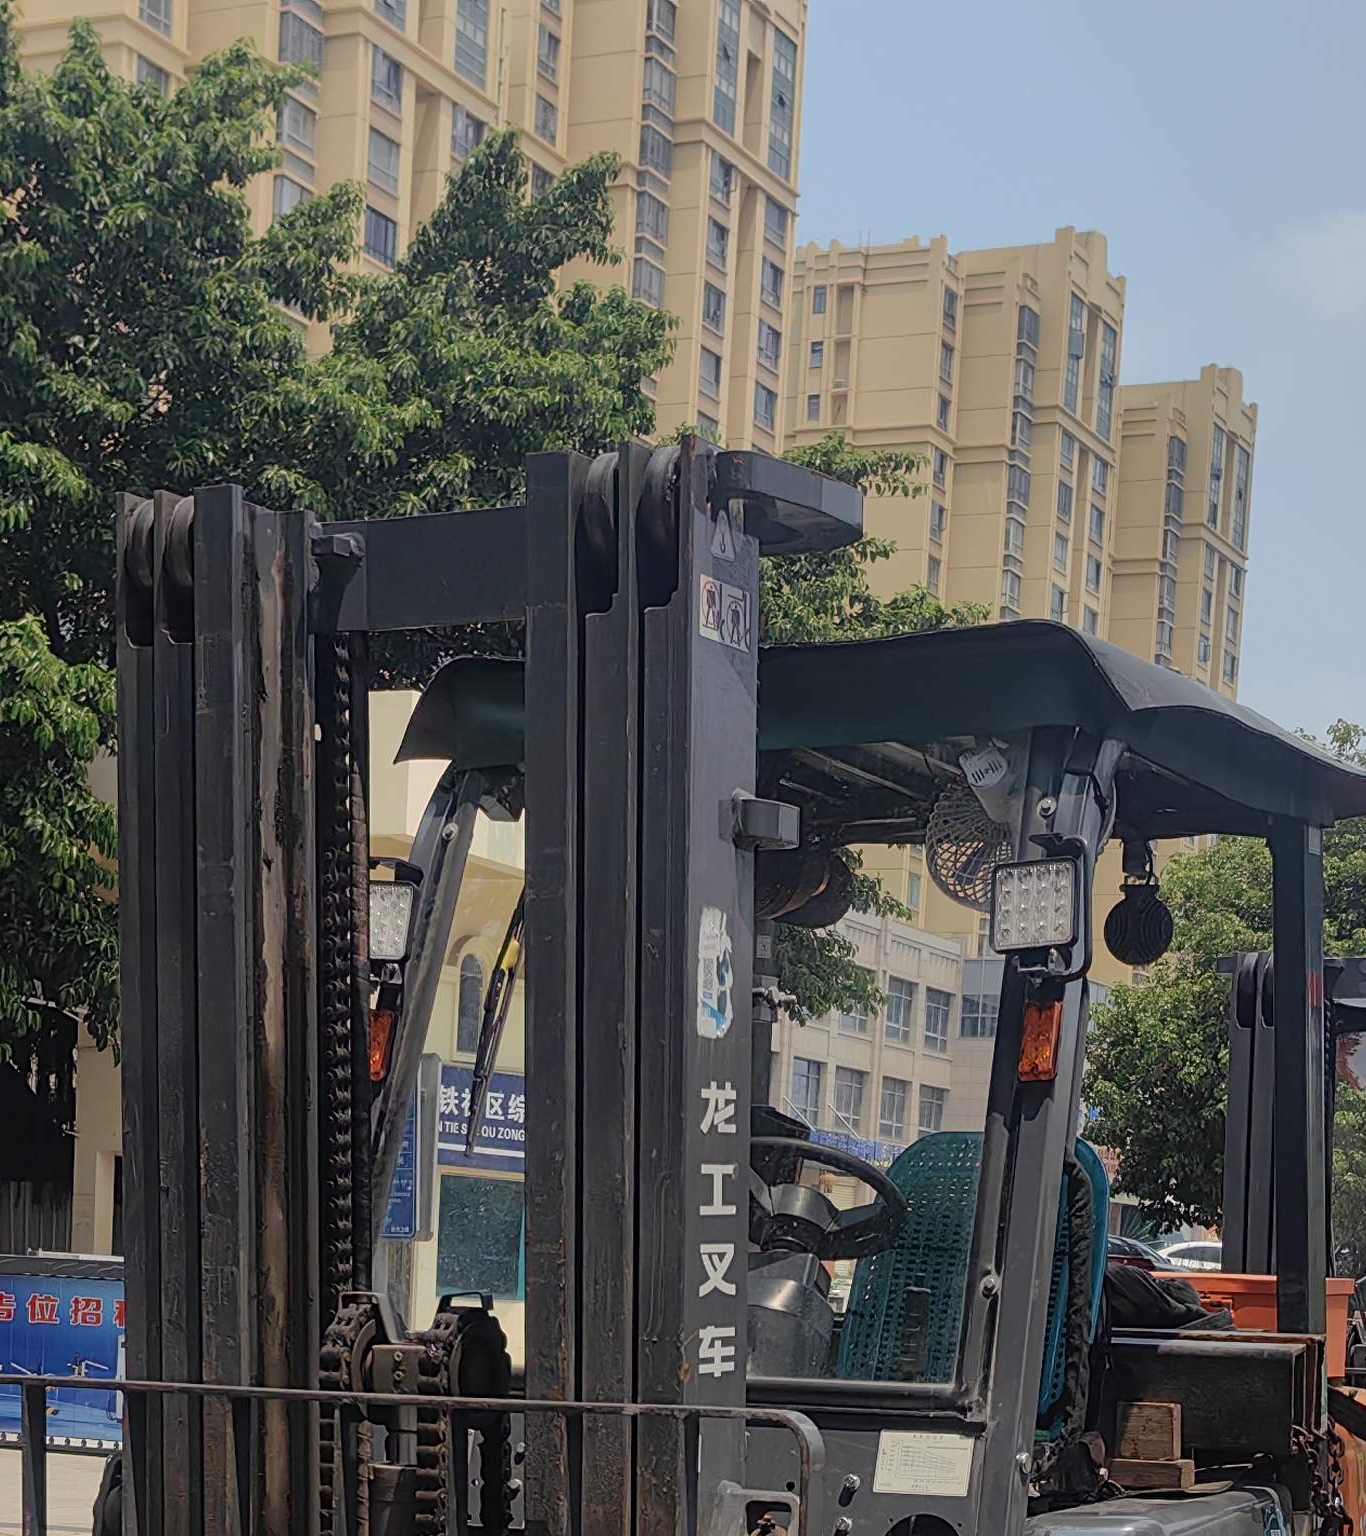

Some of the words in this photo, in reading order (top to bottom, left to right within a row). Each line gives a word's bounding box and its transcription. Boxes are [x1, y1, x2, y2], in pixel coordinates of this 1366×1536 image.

[445, 1122, 460, 1134] TIE
[481, 1125, 496, 1138] QU
[498, 1127, 525, 1141] ZONG
[698, 1081, 738, 1378] 龙工叉车
